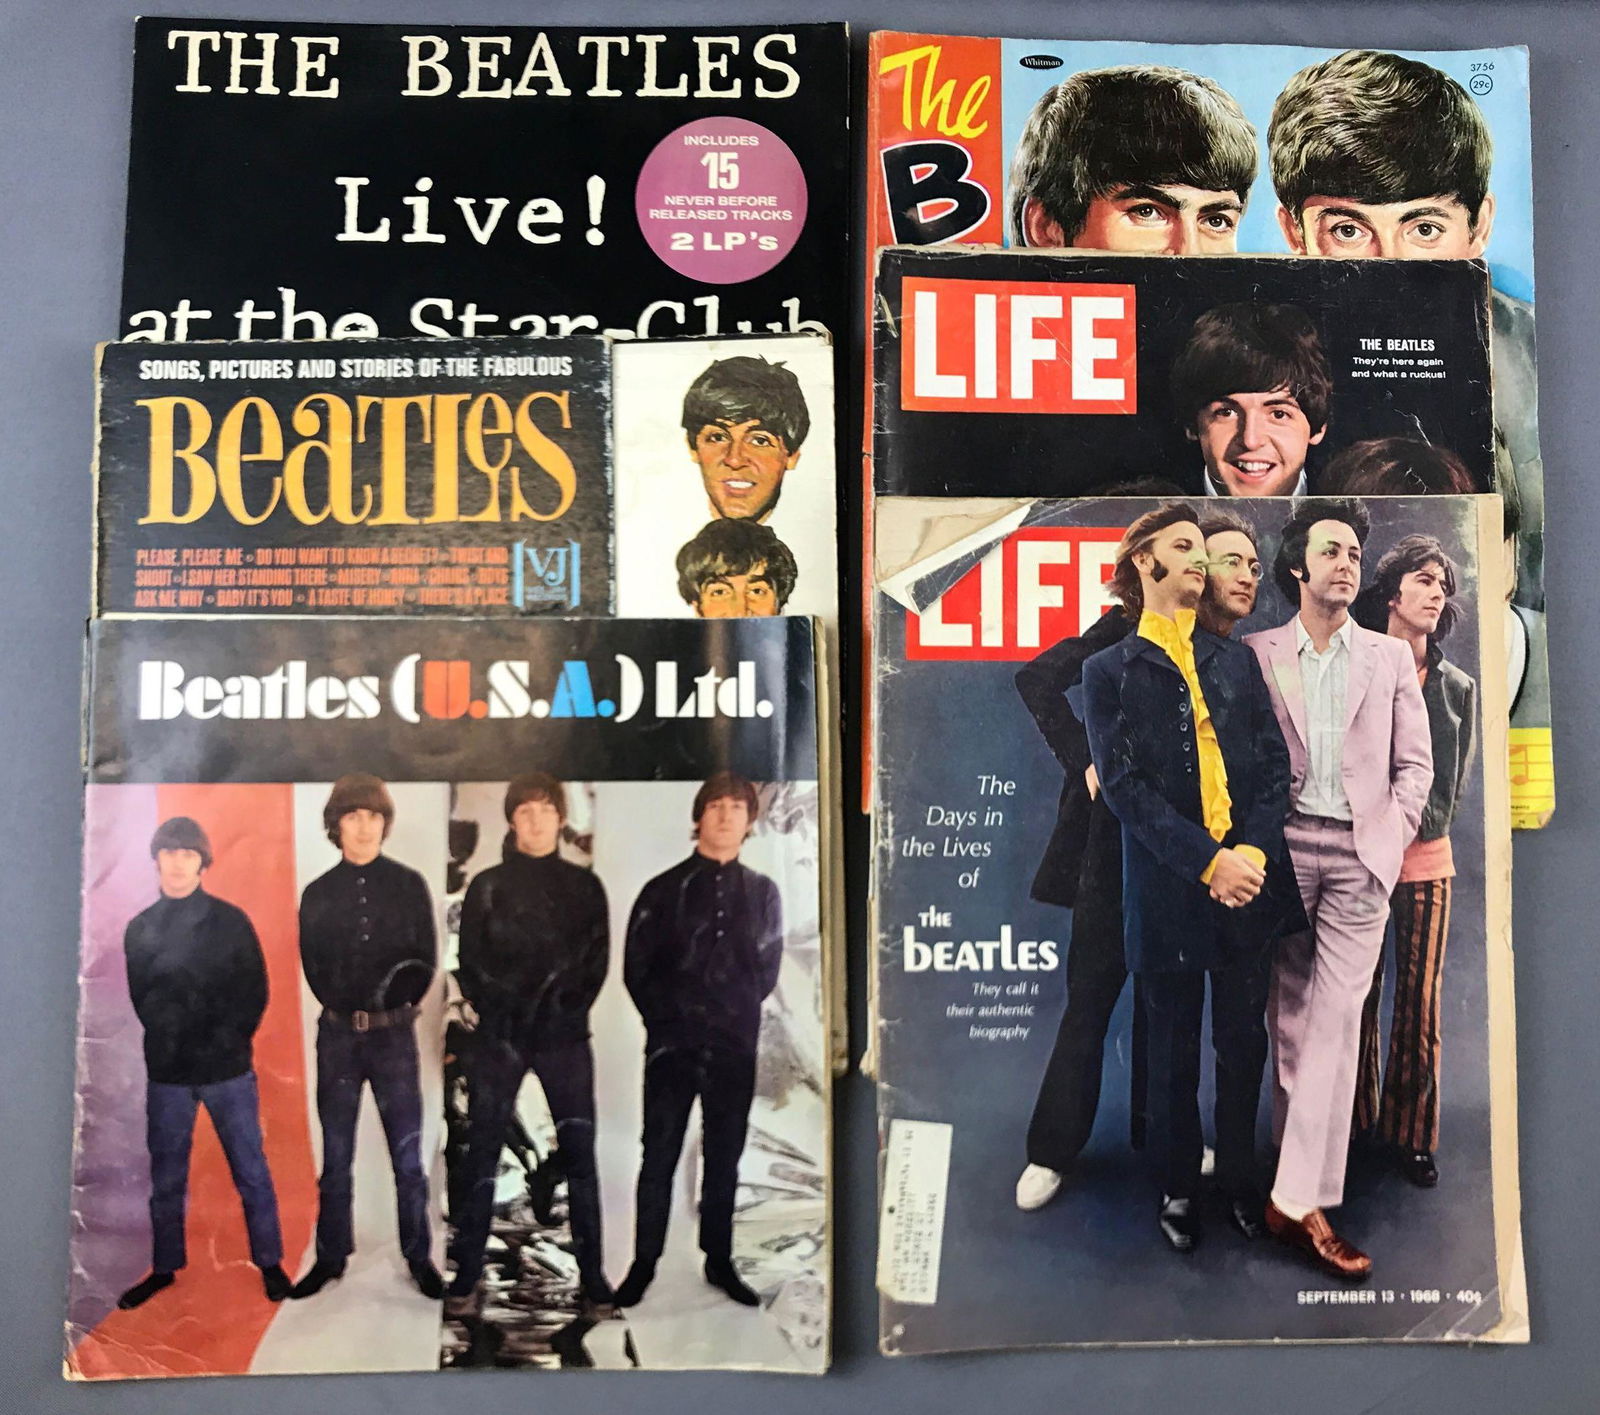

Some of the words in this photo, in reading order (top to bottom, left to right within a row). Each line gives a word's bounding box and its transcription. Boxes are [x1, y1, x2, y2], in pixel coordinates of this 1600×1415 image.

[168, 30, 340, 99] THE
[400, 33, 801, 99] BEATLES
[1024, 57, 1061, 66] Whitman
[1470, 62, 1495, 72] 3756
[879, 45, 991, 139] The
[684, 135, 760, 147] INCLUDES
[700, 152, 740, 190] 15
[335, 174, 606, 246] Live!
[664, 195, 715, 206] NEVER
[718, 196, 778, 207] BEFORE
[649, 209, 728, 220] RELEASED
[731, 210, 793, 221] TRACKS
[670, 232, 695, 251] 2
[703, 231, 779, 251] LP's
[123, 299, 212, 342] at
[234, 286, 379, 341] the
[914, 290, 1126, 401] LIFE
[1360, 339, 1383, 351] THE
[1387, 339, 1436, 351] BEATLES
[139, 360, 205, 382] SONGS,
[209, 359, 293, 379] PICTURES
[297, 359, 336, 379] AND
[340, 358, 414, 378] STORIES
[418, 357, 441, 377] OF
[445, 357, 478, 377] THE
[483, 356, 573, 377] FABULOUS
[1352, 356, 1390, 367] They're
[1392, 357, 1415, 366] here
[1417, 358, 1444, 367] again
[1351, 370, 1370, 378] and
[1373, 370, 1398, 378] what
[1410, 371, 1446, 379] ruckus!
[181, 548, 222, 565] PLEASE
[224, 548, 243, 565] ME
[256, 548, 272, 565] DO
[274, 547, 296, 565] YOU
[332, 547, 345, 564] TO
[136, 569, 173, 587] SHOUT
[189, 569, 213, 586] SAW
[214, 569, 236, 586] HER
[295, 568, 328, 586] THERE
[135, 589, 157, 607] ASK
[159, 589, 177, 607] ME
[179, 589, 204, 607] WHY
[271, 589, 293, 606] YOU
[139, 660, 380, 720] Beatles
[390, 653, 644, 724] (U.S.A.)
[655, 660, 773, 719] Ltd.
[977, 775, 1016, 796] The
[926, 806, 977, 831] Days
[984, 806, 1003, 826] in
[902, 836, 935, 857] the
[943, 837, 991, 857] Lives
[958, 867, 980, 888] of
[972, 982, 1001, 999] They
[1006, 981, 1027, 995] call
[1030, 982, 1039, 995] it
[946, 1003, 974, 1017] their
[978, 1003, 1035, 1017] authentic
[969, 1024, 1030, 1041] biography
[1297, 1290, 1376, 1304] SEPTEMBER
[1381, 1290, 1395, 1303] 13
[1410, 1289, 1440, 1303] 1968
